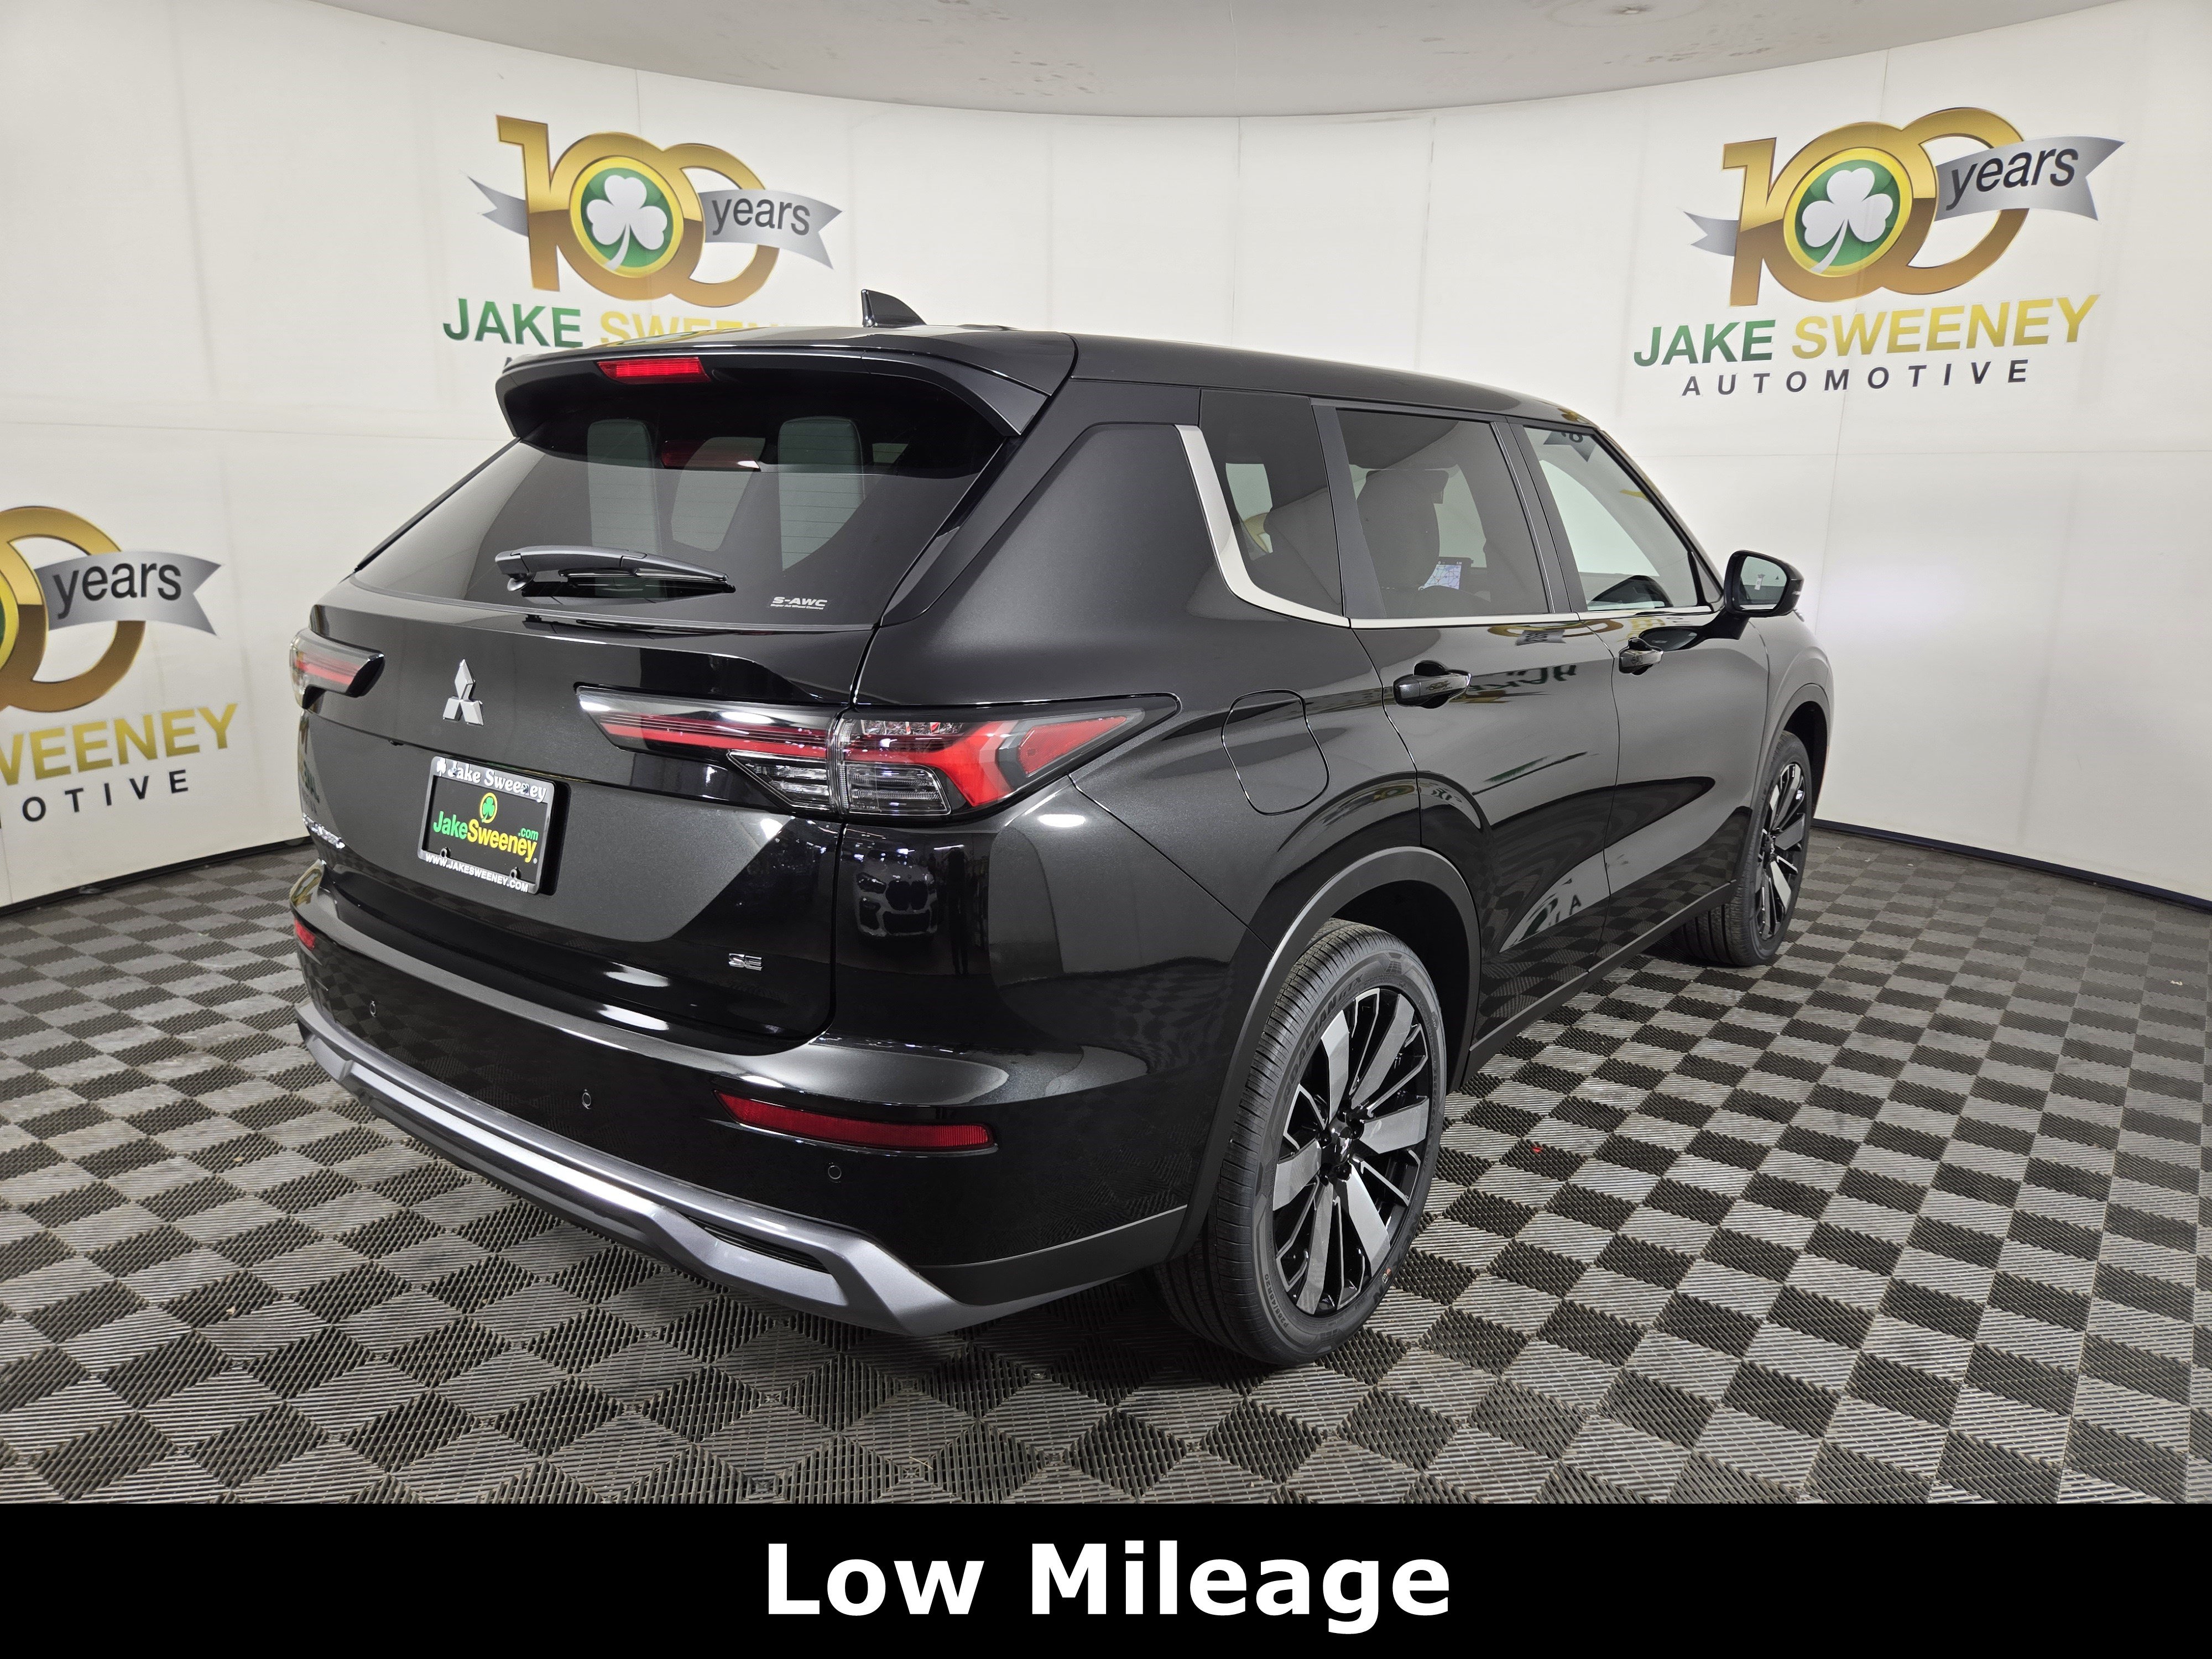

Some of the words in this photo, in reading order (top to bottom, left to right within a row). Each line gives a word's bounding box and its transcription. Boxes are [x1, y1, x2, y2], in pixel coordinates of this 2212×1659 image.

[1945, 148, 2078, 211] years
[711, 197, 811, 236] years
[443, 298, 584, 349] JAKE
[1633, 320, 1776, 367] JAKE
[1791, 294, 2100, 360] SWEENEY
[1682, 359, 2030, 397] AUTOMOTIVE
[53, 562, 182, 620] years
[772, 596, 828, 607] S-AWC
[447, 760, 481, 784] Jake
[484, 768, 547, 803] Sweeney
[425, 853, 529, 893] WWW.JAKESWEENEY.COM
[728, 953, 763, 971] SE
